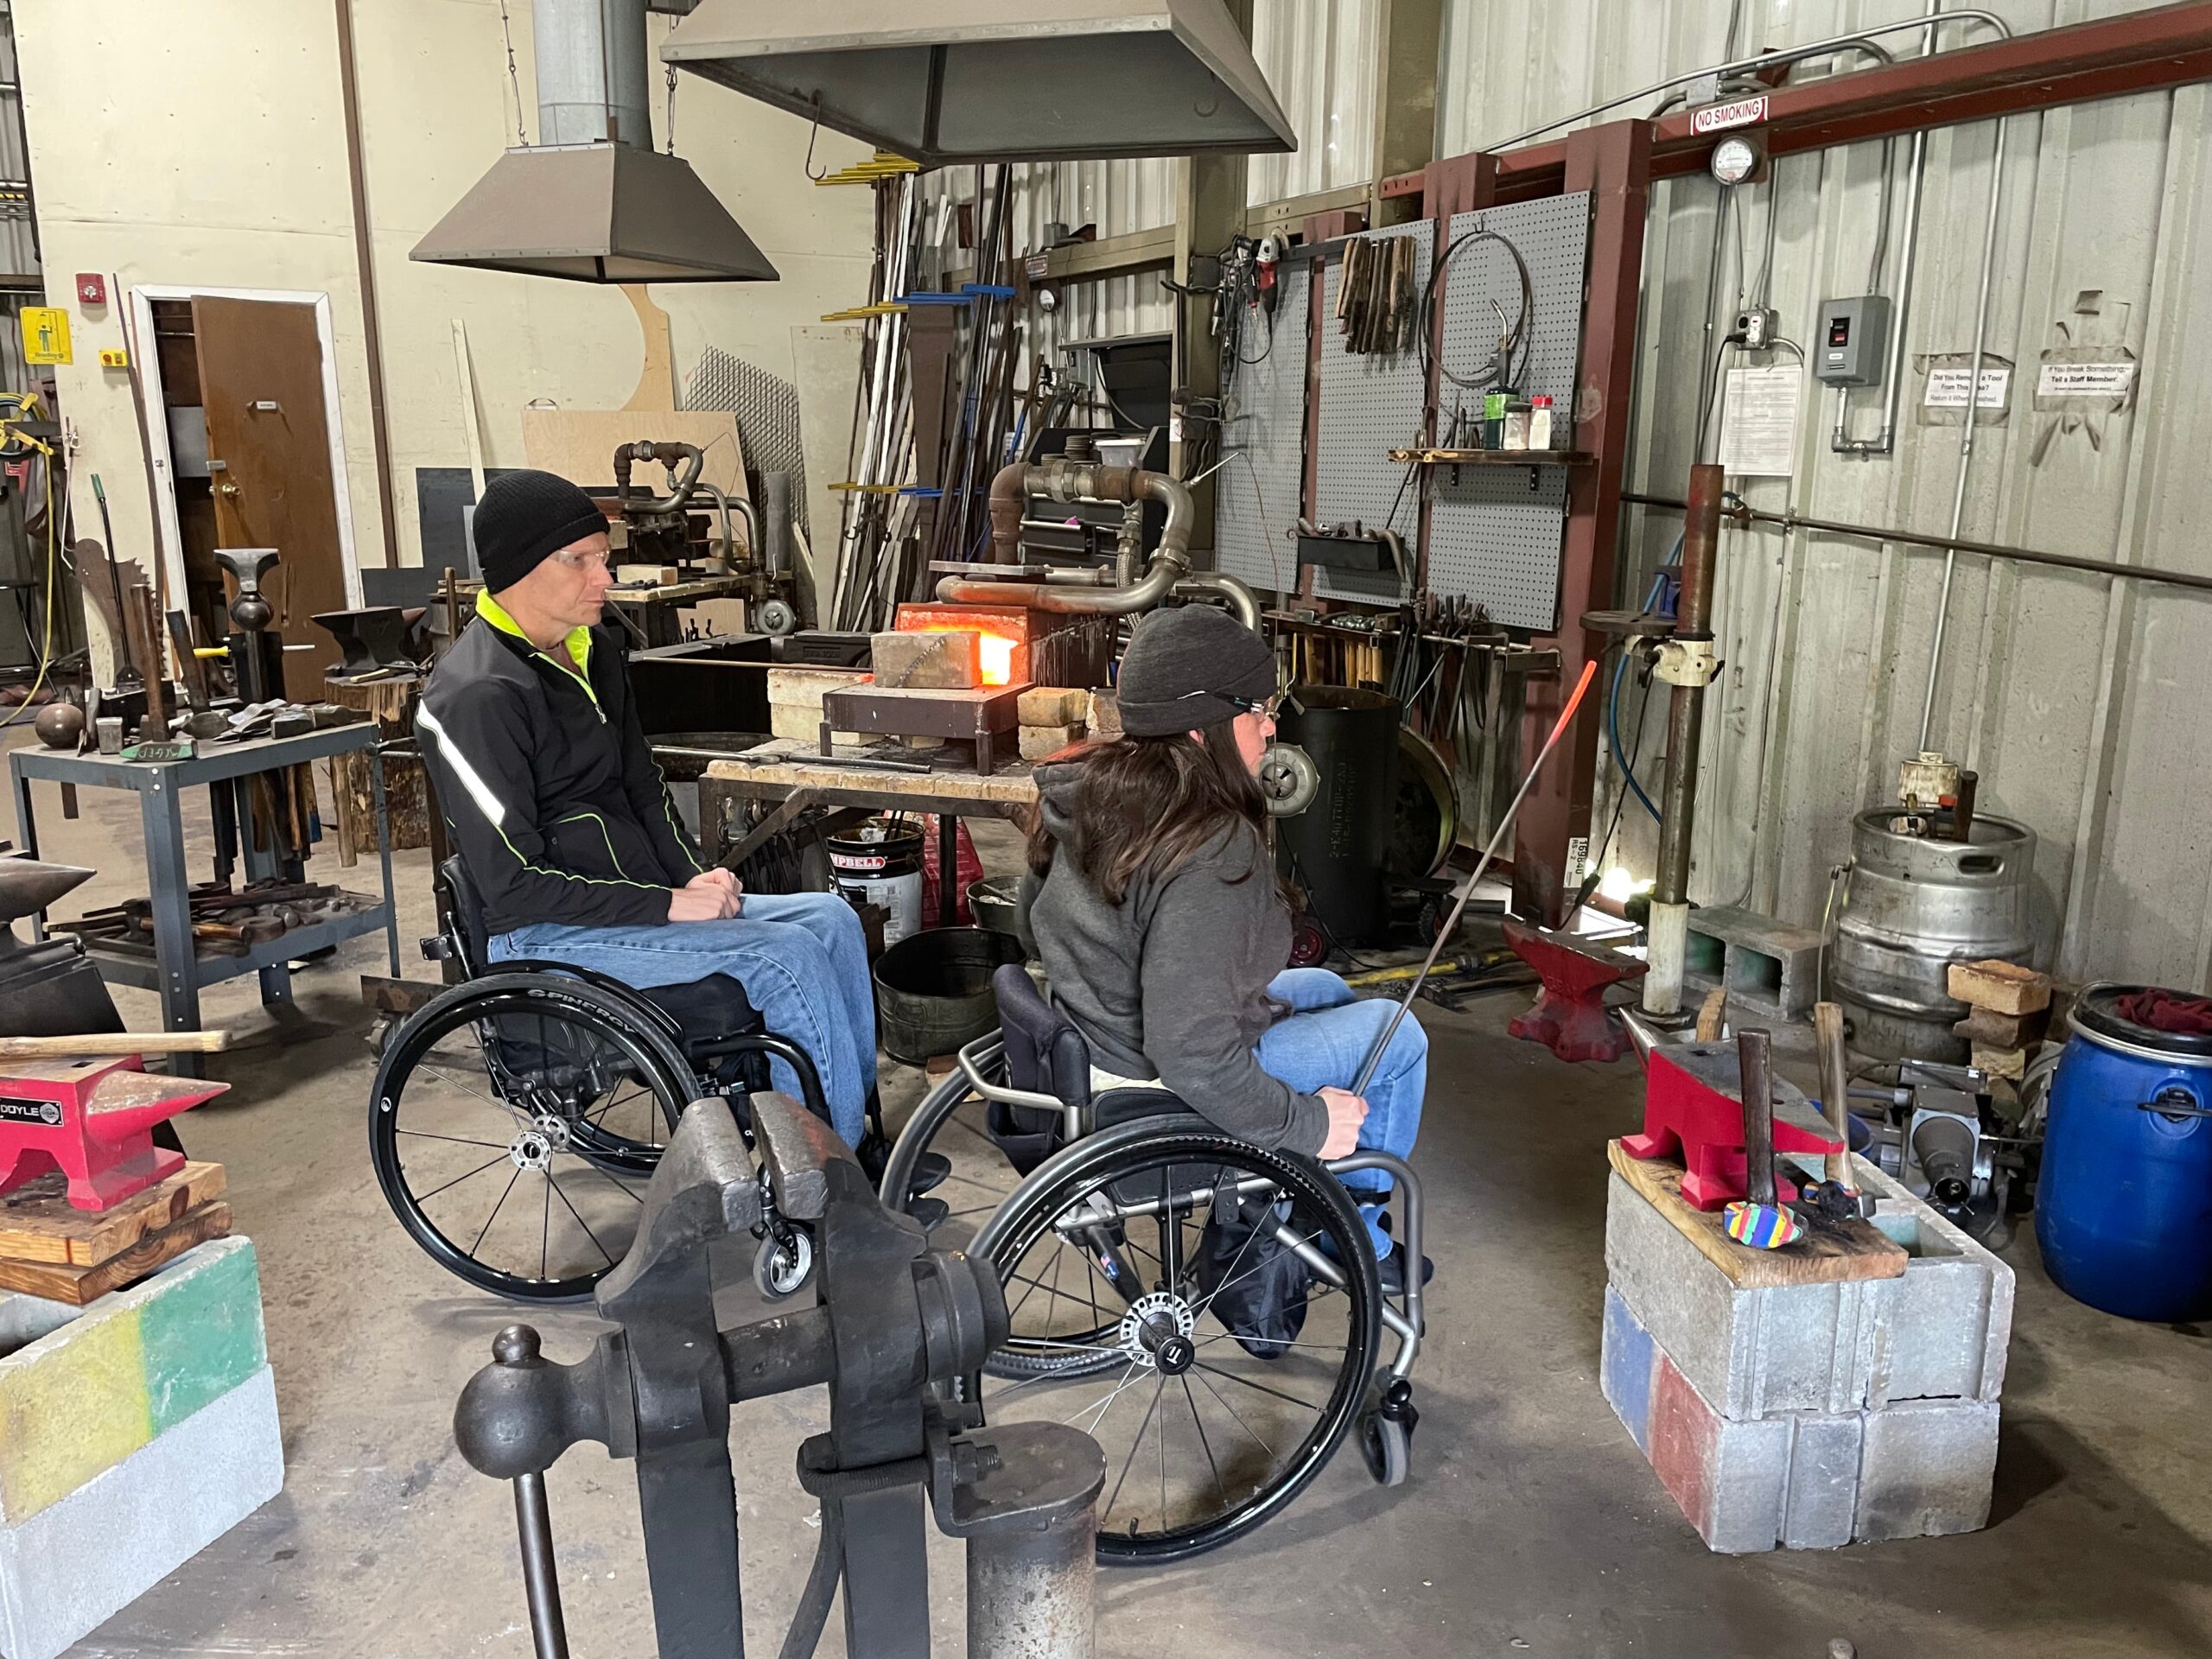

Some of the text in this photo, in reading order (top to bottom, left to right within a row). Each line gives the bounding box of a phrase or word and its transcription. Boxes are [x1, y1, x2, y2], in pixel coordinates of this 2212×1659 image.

[1699, 100, 1759, 128] NO SMOKING
[527, 988, 637, 1033] SPINERGY
[0, 1104, 40, 1116] DOYLE
